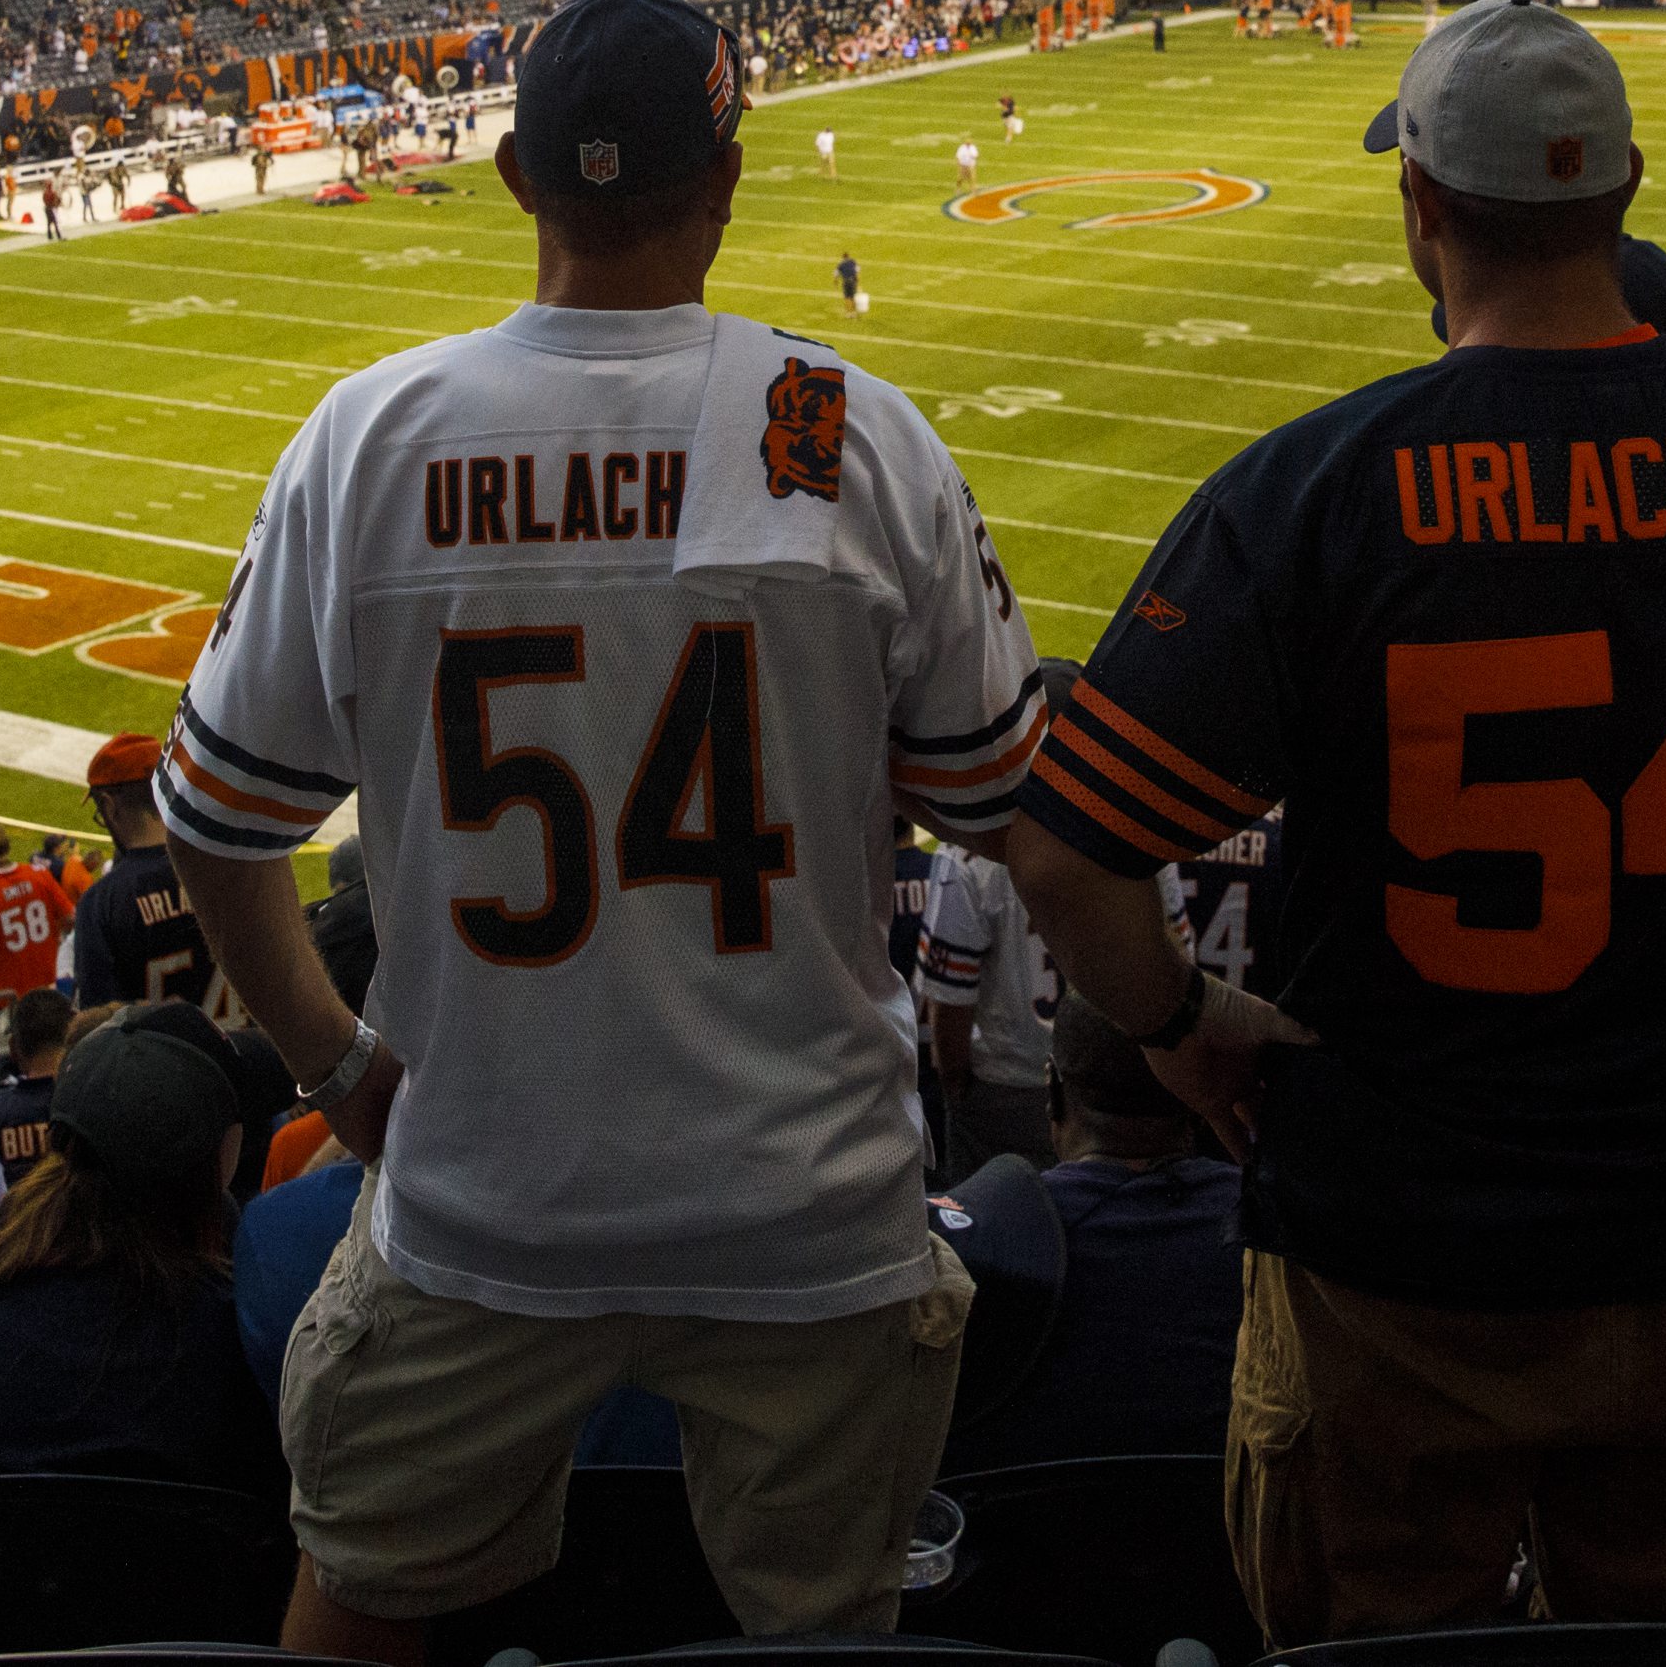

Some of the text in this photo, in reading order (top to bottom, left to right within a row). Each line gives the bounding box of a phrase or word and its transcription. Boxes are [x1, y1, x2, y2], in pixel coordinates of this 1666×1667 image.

[587, 159, 615, 175] NFL
[425, 450, 687, 547] URLACH
[433, 621, 796, 968] 54
[0, 899, 51, 953] 58
